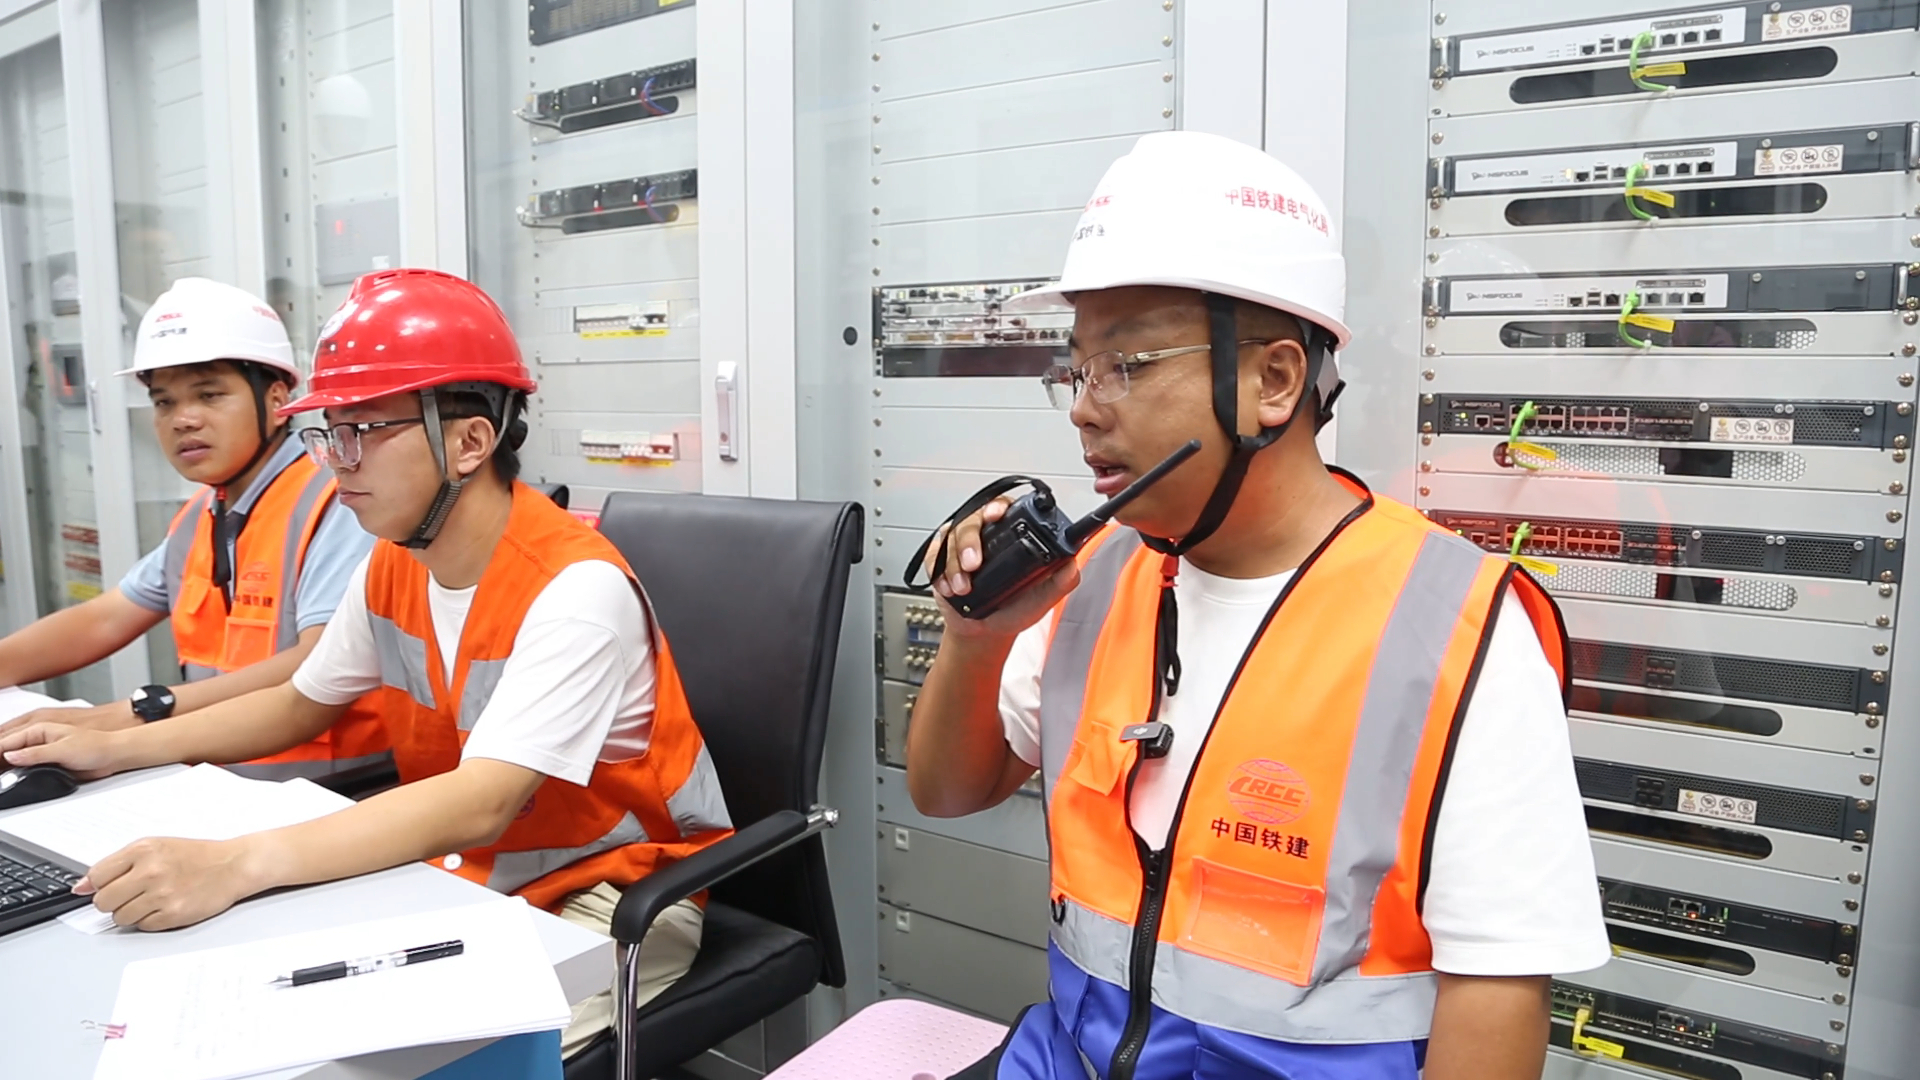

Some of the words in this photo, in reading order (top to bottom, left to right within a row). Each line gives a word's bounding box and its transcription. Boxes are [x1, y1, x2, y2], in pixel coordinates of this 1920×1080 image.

[1493, 45, 1535, 55] NSFOCUS
[1487, 169, 1529, 178] NSFOCUS
[1225, 186, 1329, 238] 中国铁建电气化局
[1482, 292, 1524, 300] NSFOCUS
[1229, 776, 1305, 804] CRCC
[1211, 816, 1309, 860] 中国铁建
